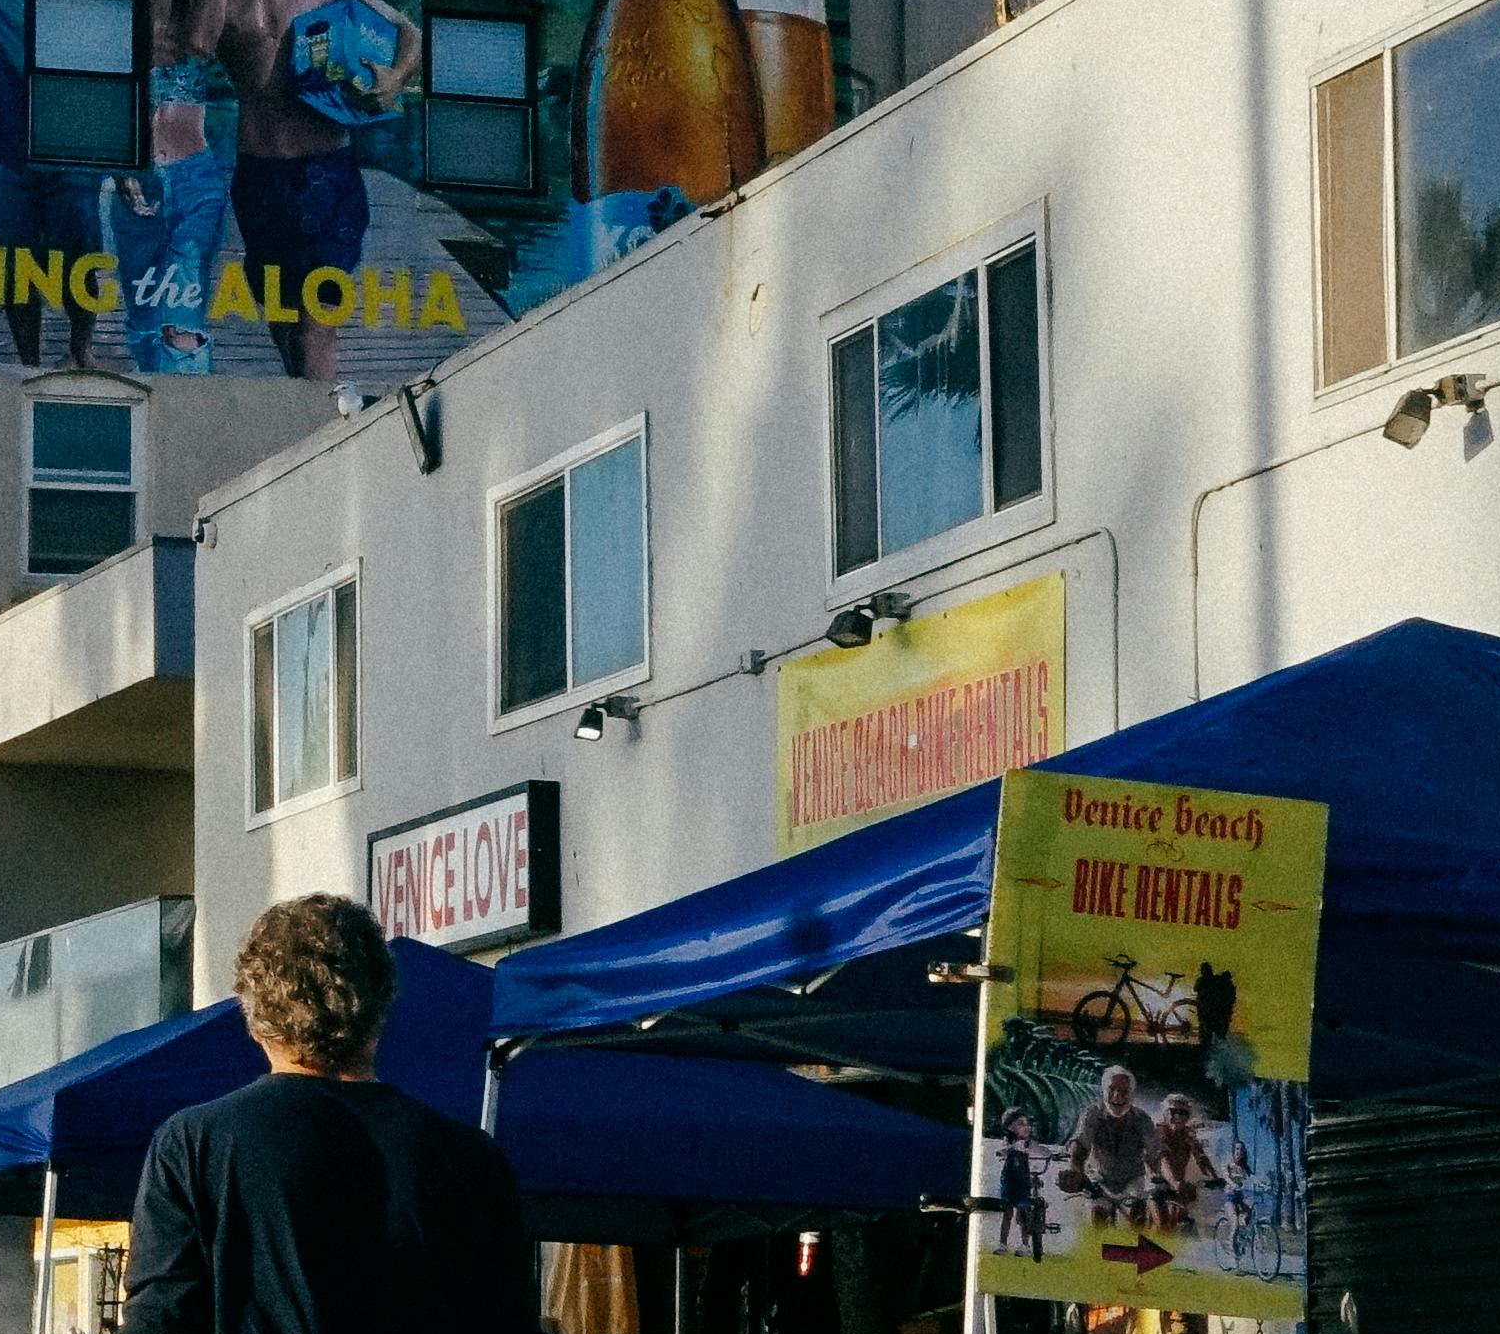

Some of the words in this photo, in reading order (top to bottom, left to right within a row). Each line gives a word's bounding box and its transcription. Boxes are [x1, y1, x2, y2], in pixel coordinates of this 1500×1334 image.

[131, 265, 203, 309] the
[209, 262, 469, 333] ALOHA
[376, 832, 456, 939] VENICE
[462, 810, 528, 922] LOVE
[1072, 858, 1130, 918] BIKE
[1134, 864, 1243, 930] RENTALS
